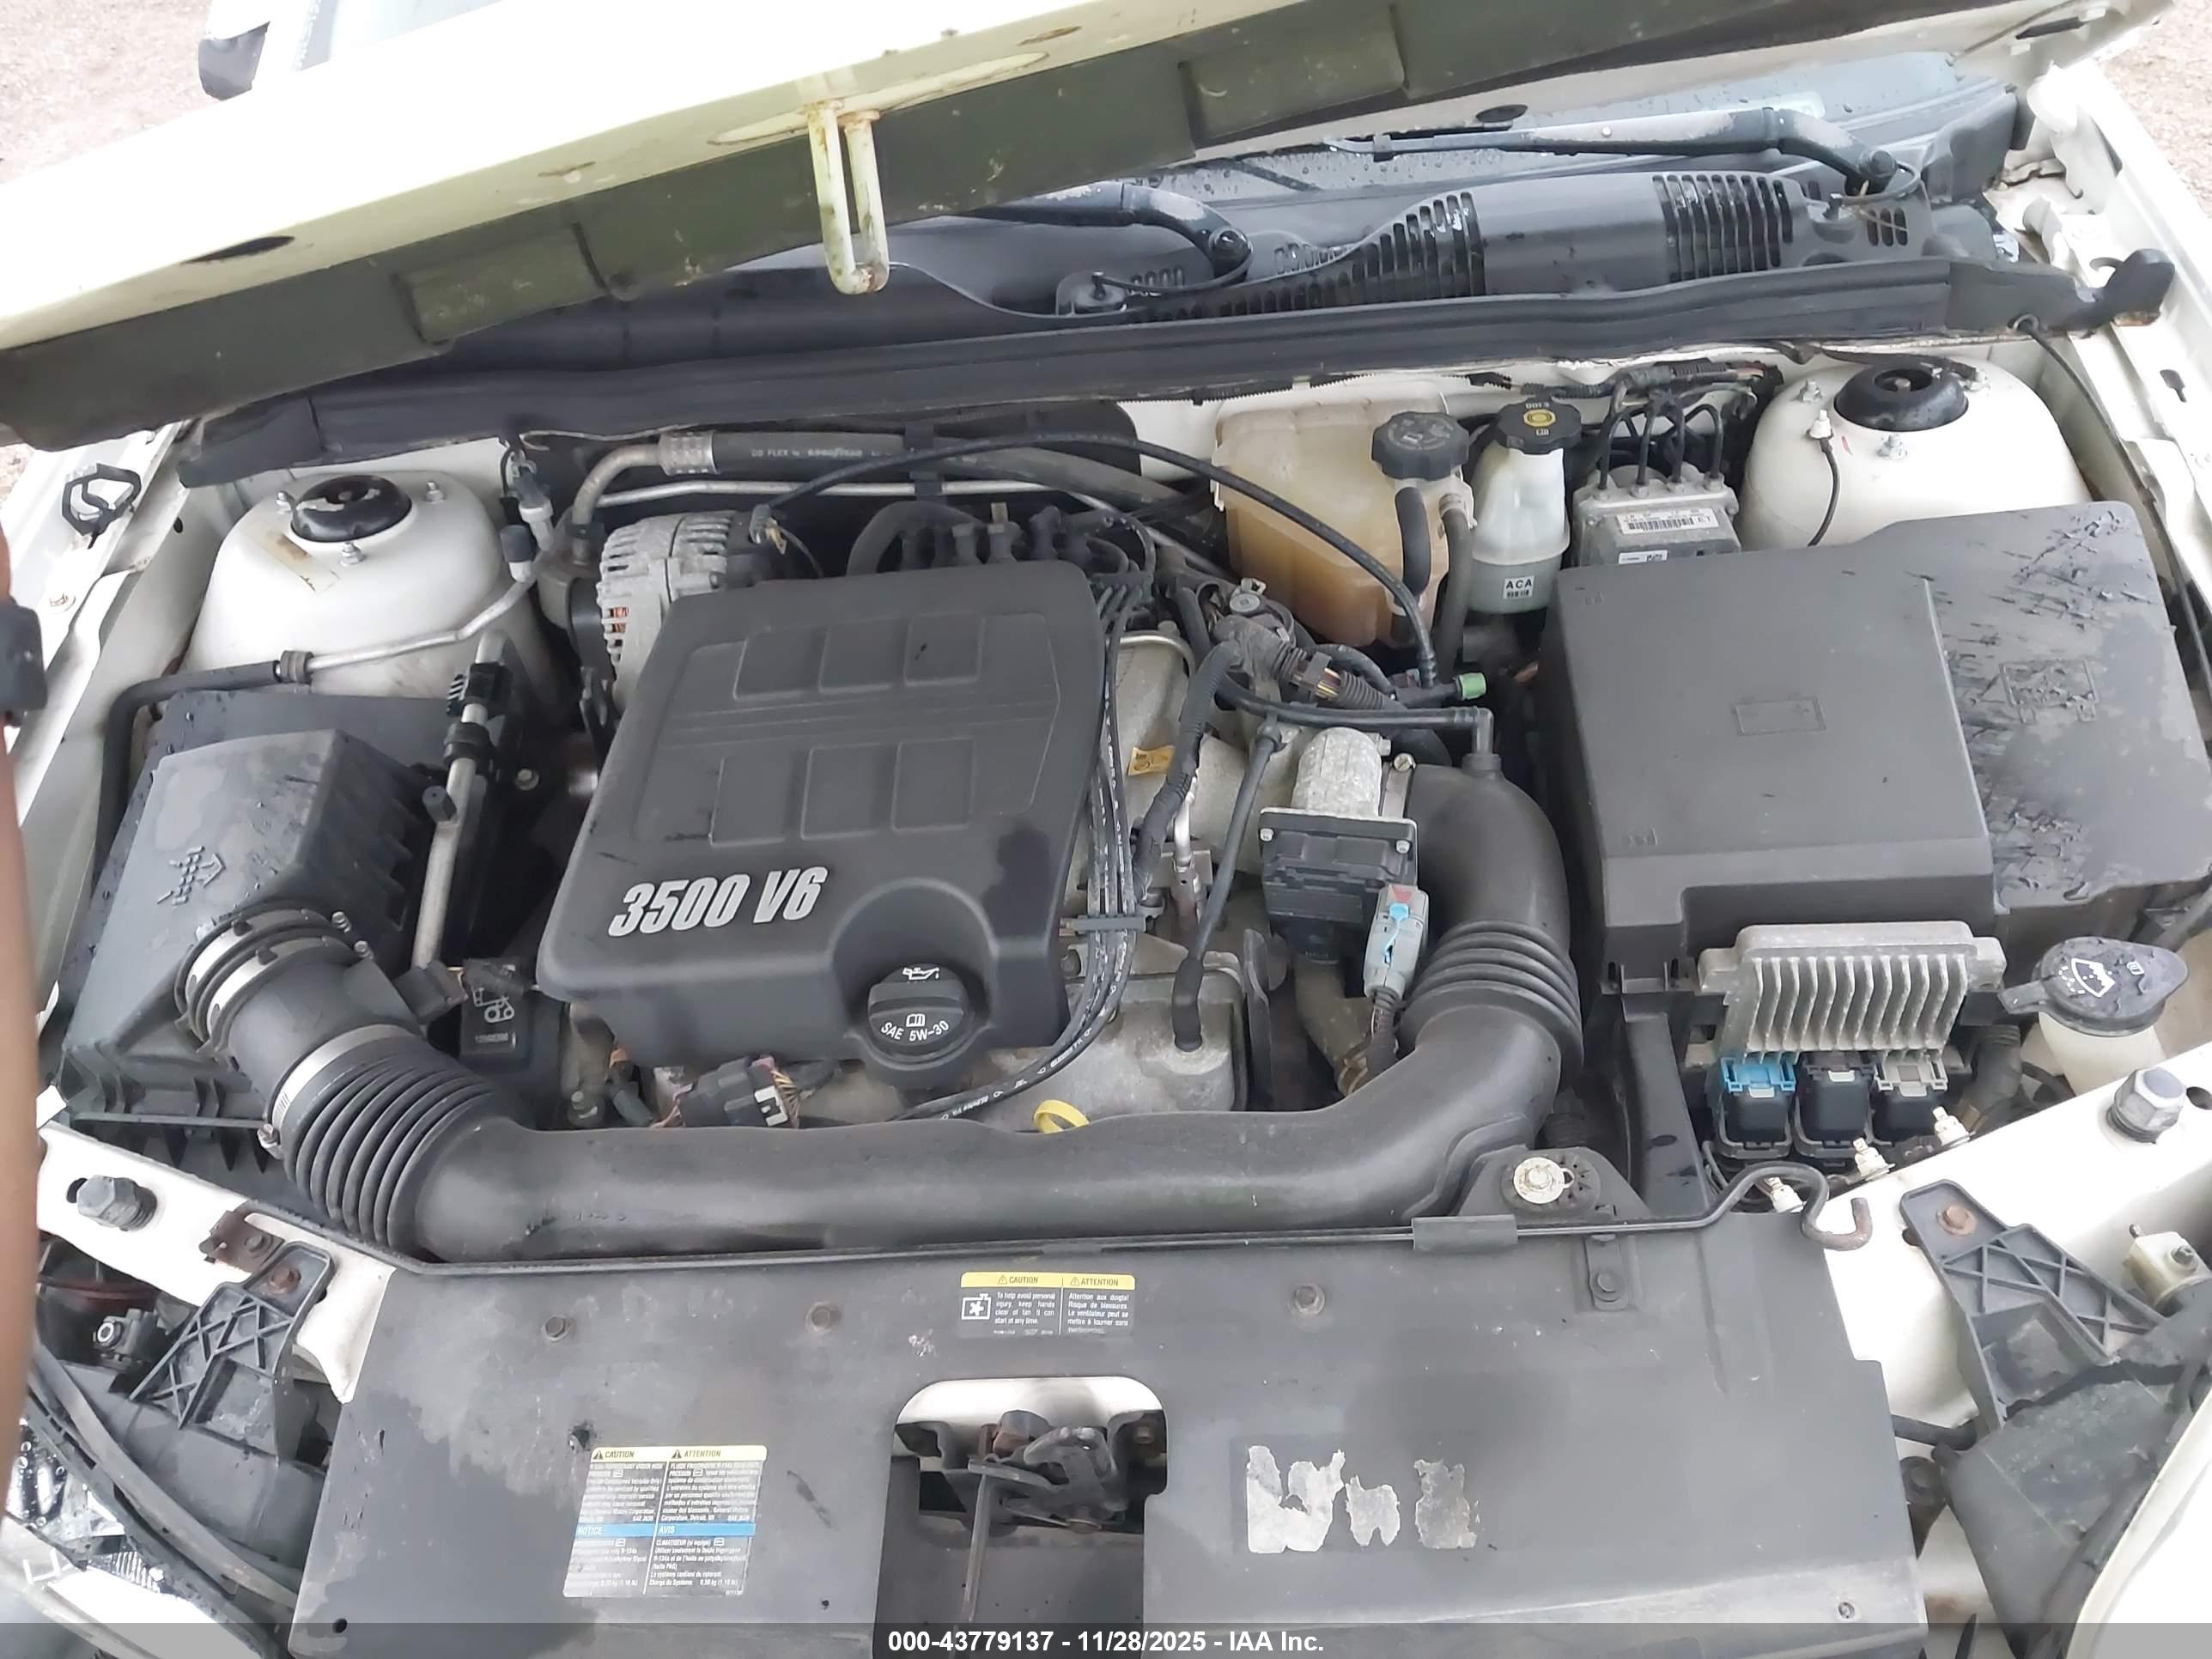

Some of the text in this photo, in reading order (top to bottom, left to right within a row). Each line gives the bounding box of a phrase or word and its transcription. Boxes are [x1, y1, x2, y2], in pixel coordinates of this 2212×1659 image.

[1506, 578, 1532, 589] ACA
[608, 866, 829, 937] 3500 V6
[881, 1020, 949, 1042] SAE 5W-30
[1081, 1278, 1118, 1286] ATTENTION
[577, 1525, 603, 1534] NOTICE
